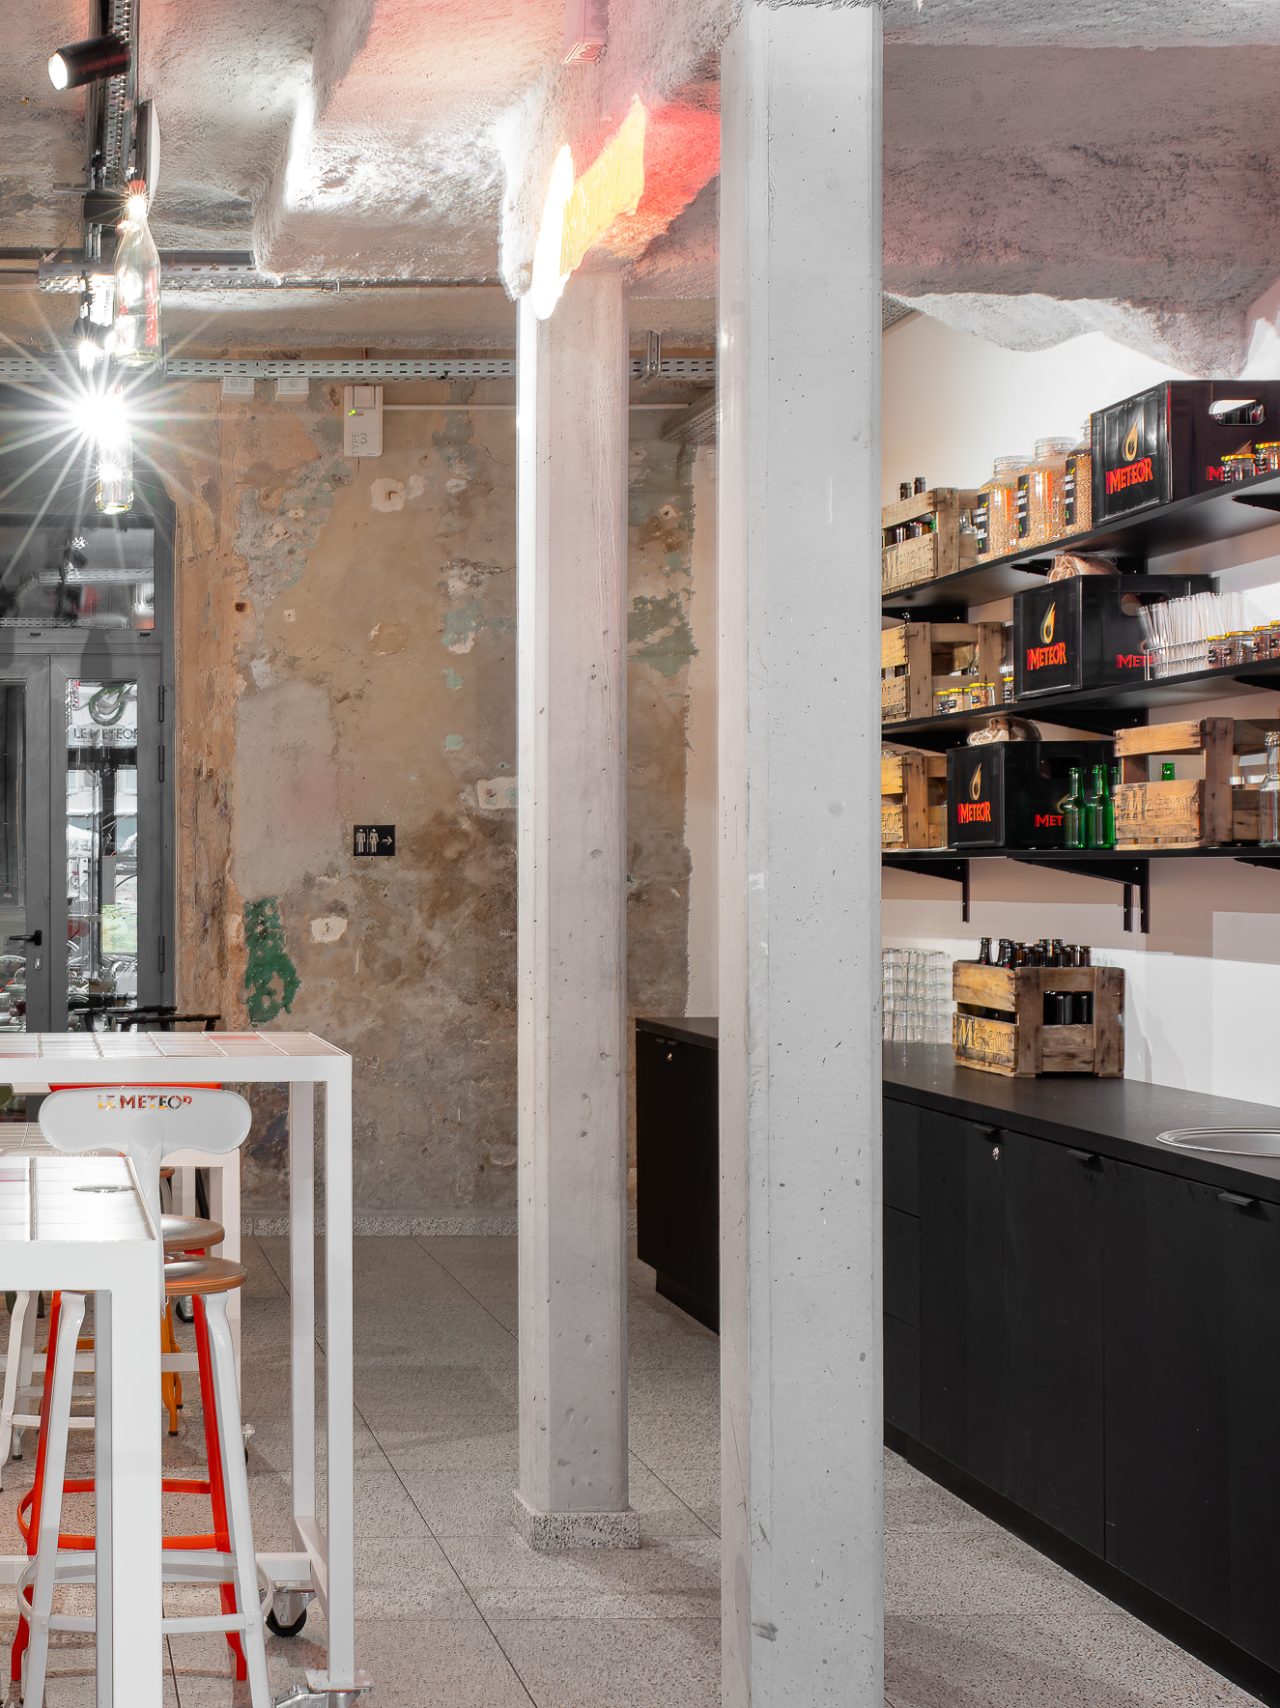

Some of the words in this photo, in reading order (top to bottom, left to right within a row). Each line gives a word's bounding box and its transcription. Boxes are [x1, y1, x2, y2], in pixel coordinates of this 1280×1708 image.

[360, 432, 368, 445] 3
[1106, 457, 1153, 494] METEOR
[1027, 642, 1067, 670] METEOR
[1115, 654, 1154, 668] MET
[958, 802, 991, 823] METEOR
[1034, 814, 1064, 827] MET
